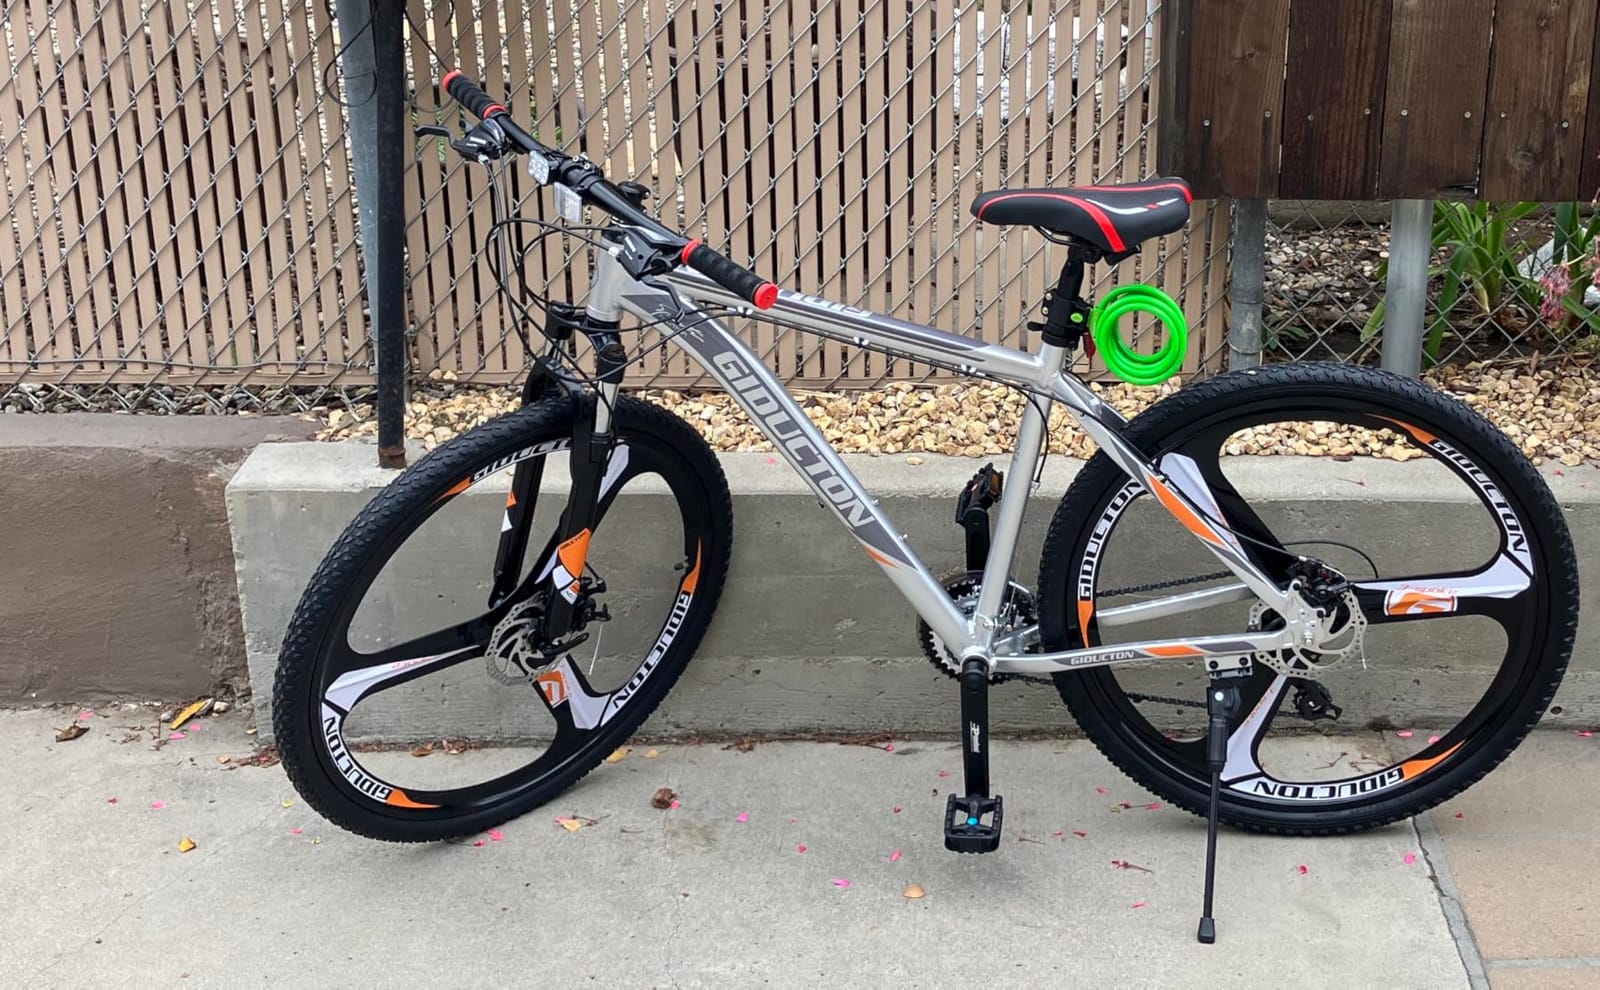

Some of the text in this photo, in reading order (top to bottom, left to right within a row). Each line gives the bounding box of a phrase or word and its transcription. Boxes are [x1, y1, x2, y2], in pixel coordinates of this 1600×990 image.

[713, 352, 875, 527] GIDUCTON
[1429, 439, 1529, 553] GIDUCTON
[1079, 481, 1142, 601] GIDUCTON
[612, 590, 692, 708] GIDUCTON
[1070, 650, 1135, 665] GIDUCTON
[324, 716, 393, 798] GIDUCTON
[1253, 768, 1404, 799] GIDUCTON
